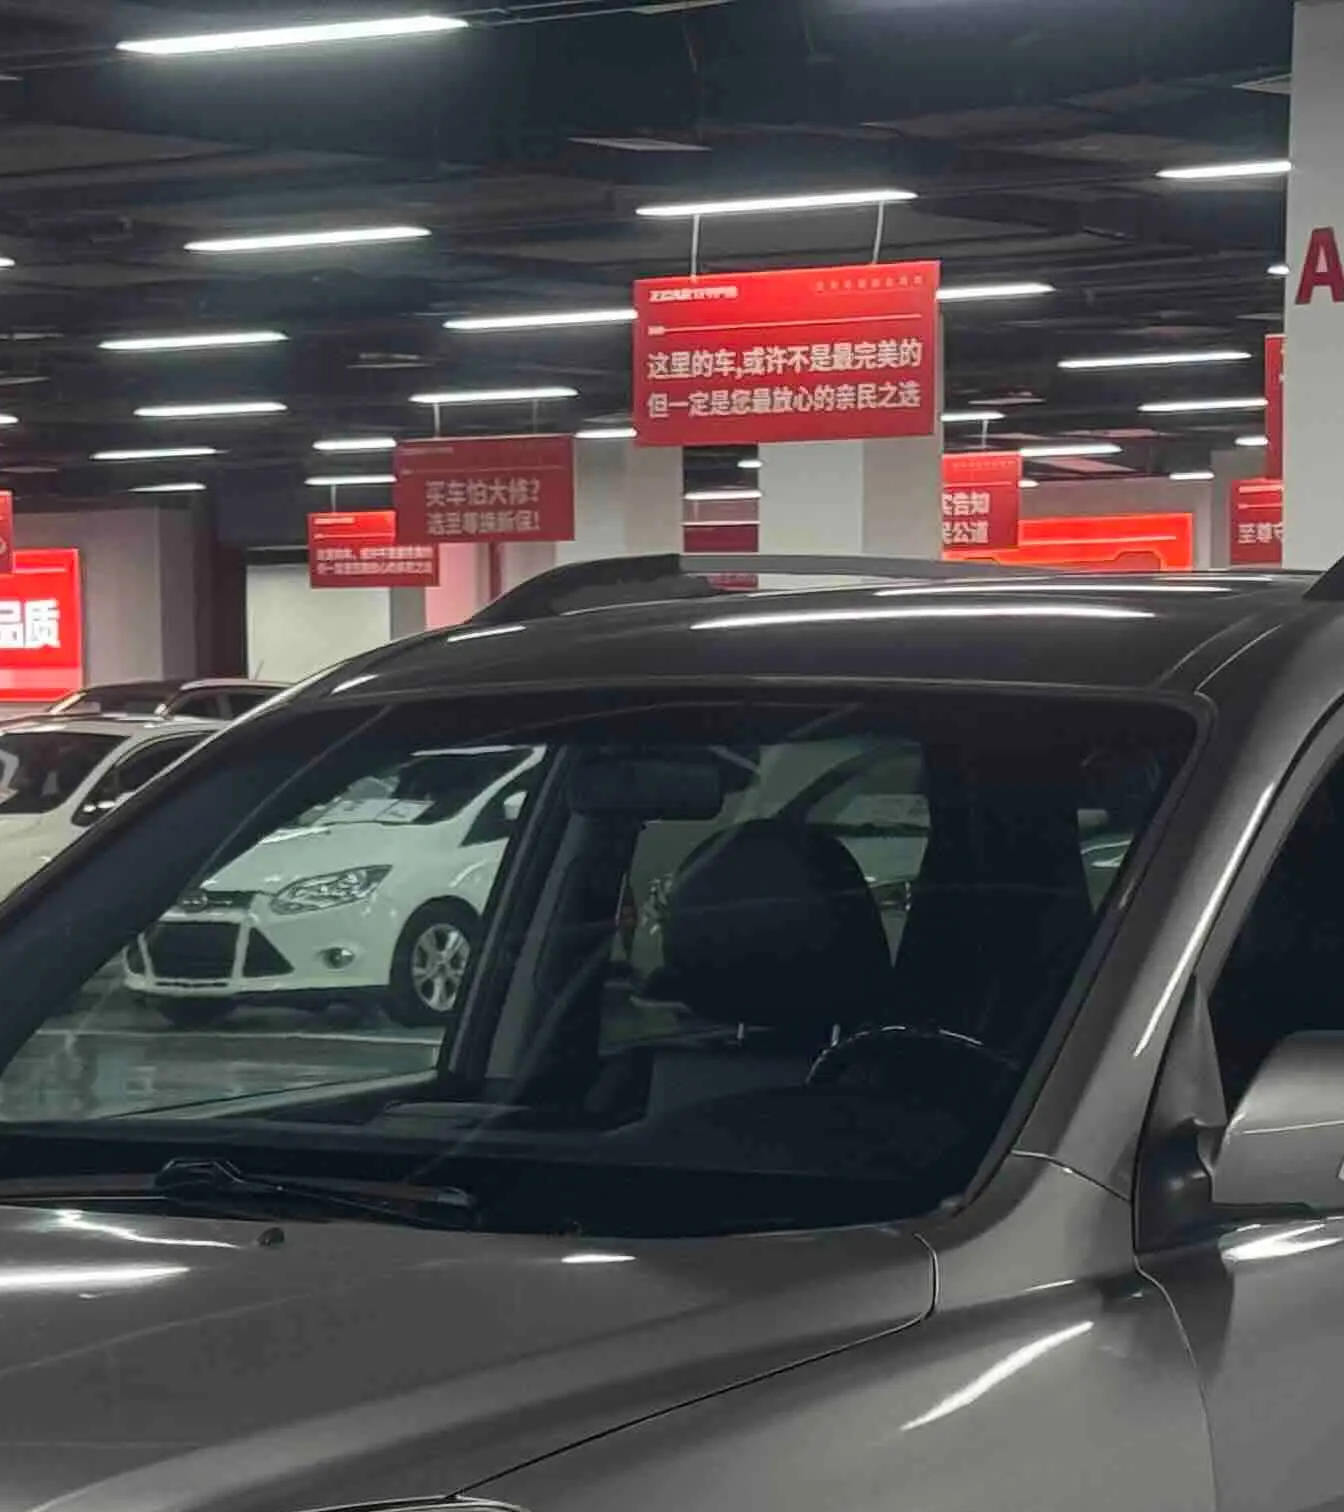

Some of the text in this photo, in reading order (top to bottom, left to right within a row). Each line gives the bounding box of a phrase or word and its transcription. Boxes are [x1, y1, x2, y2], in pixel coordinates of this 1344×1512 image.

[646, 380, 921, 419] 但一定是您最放心的亲民之选
